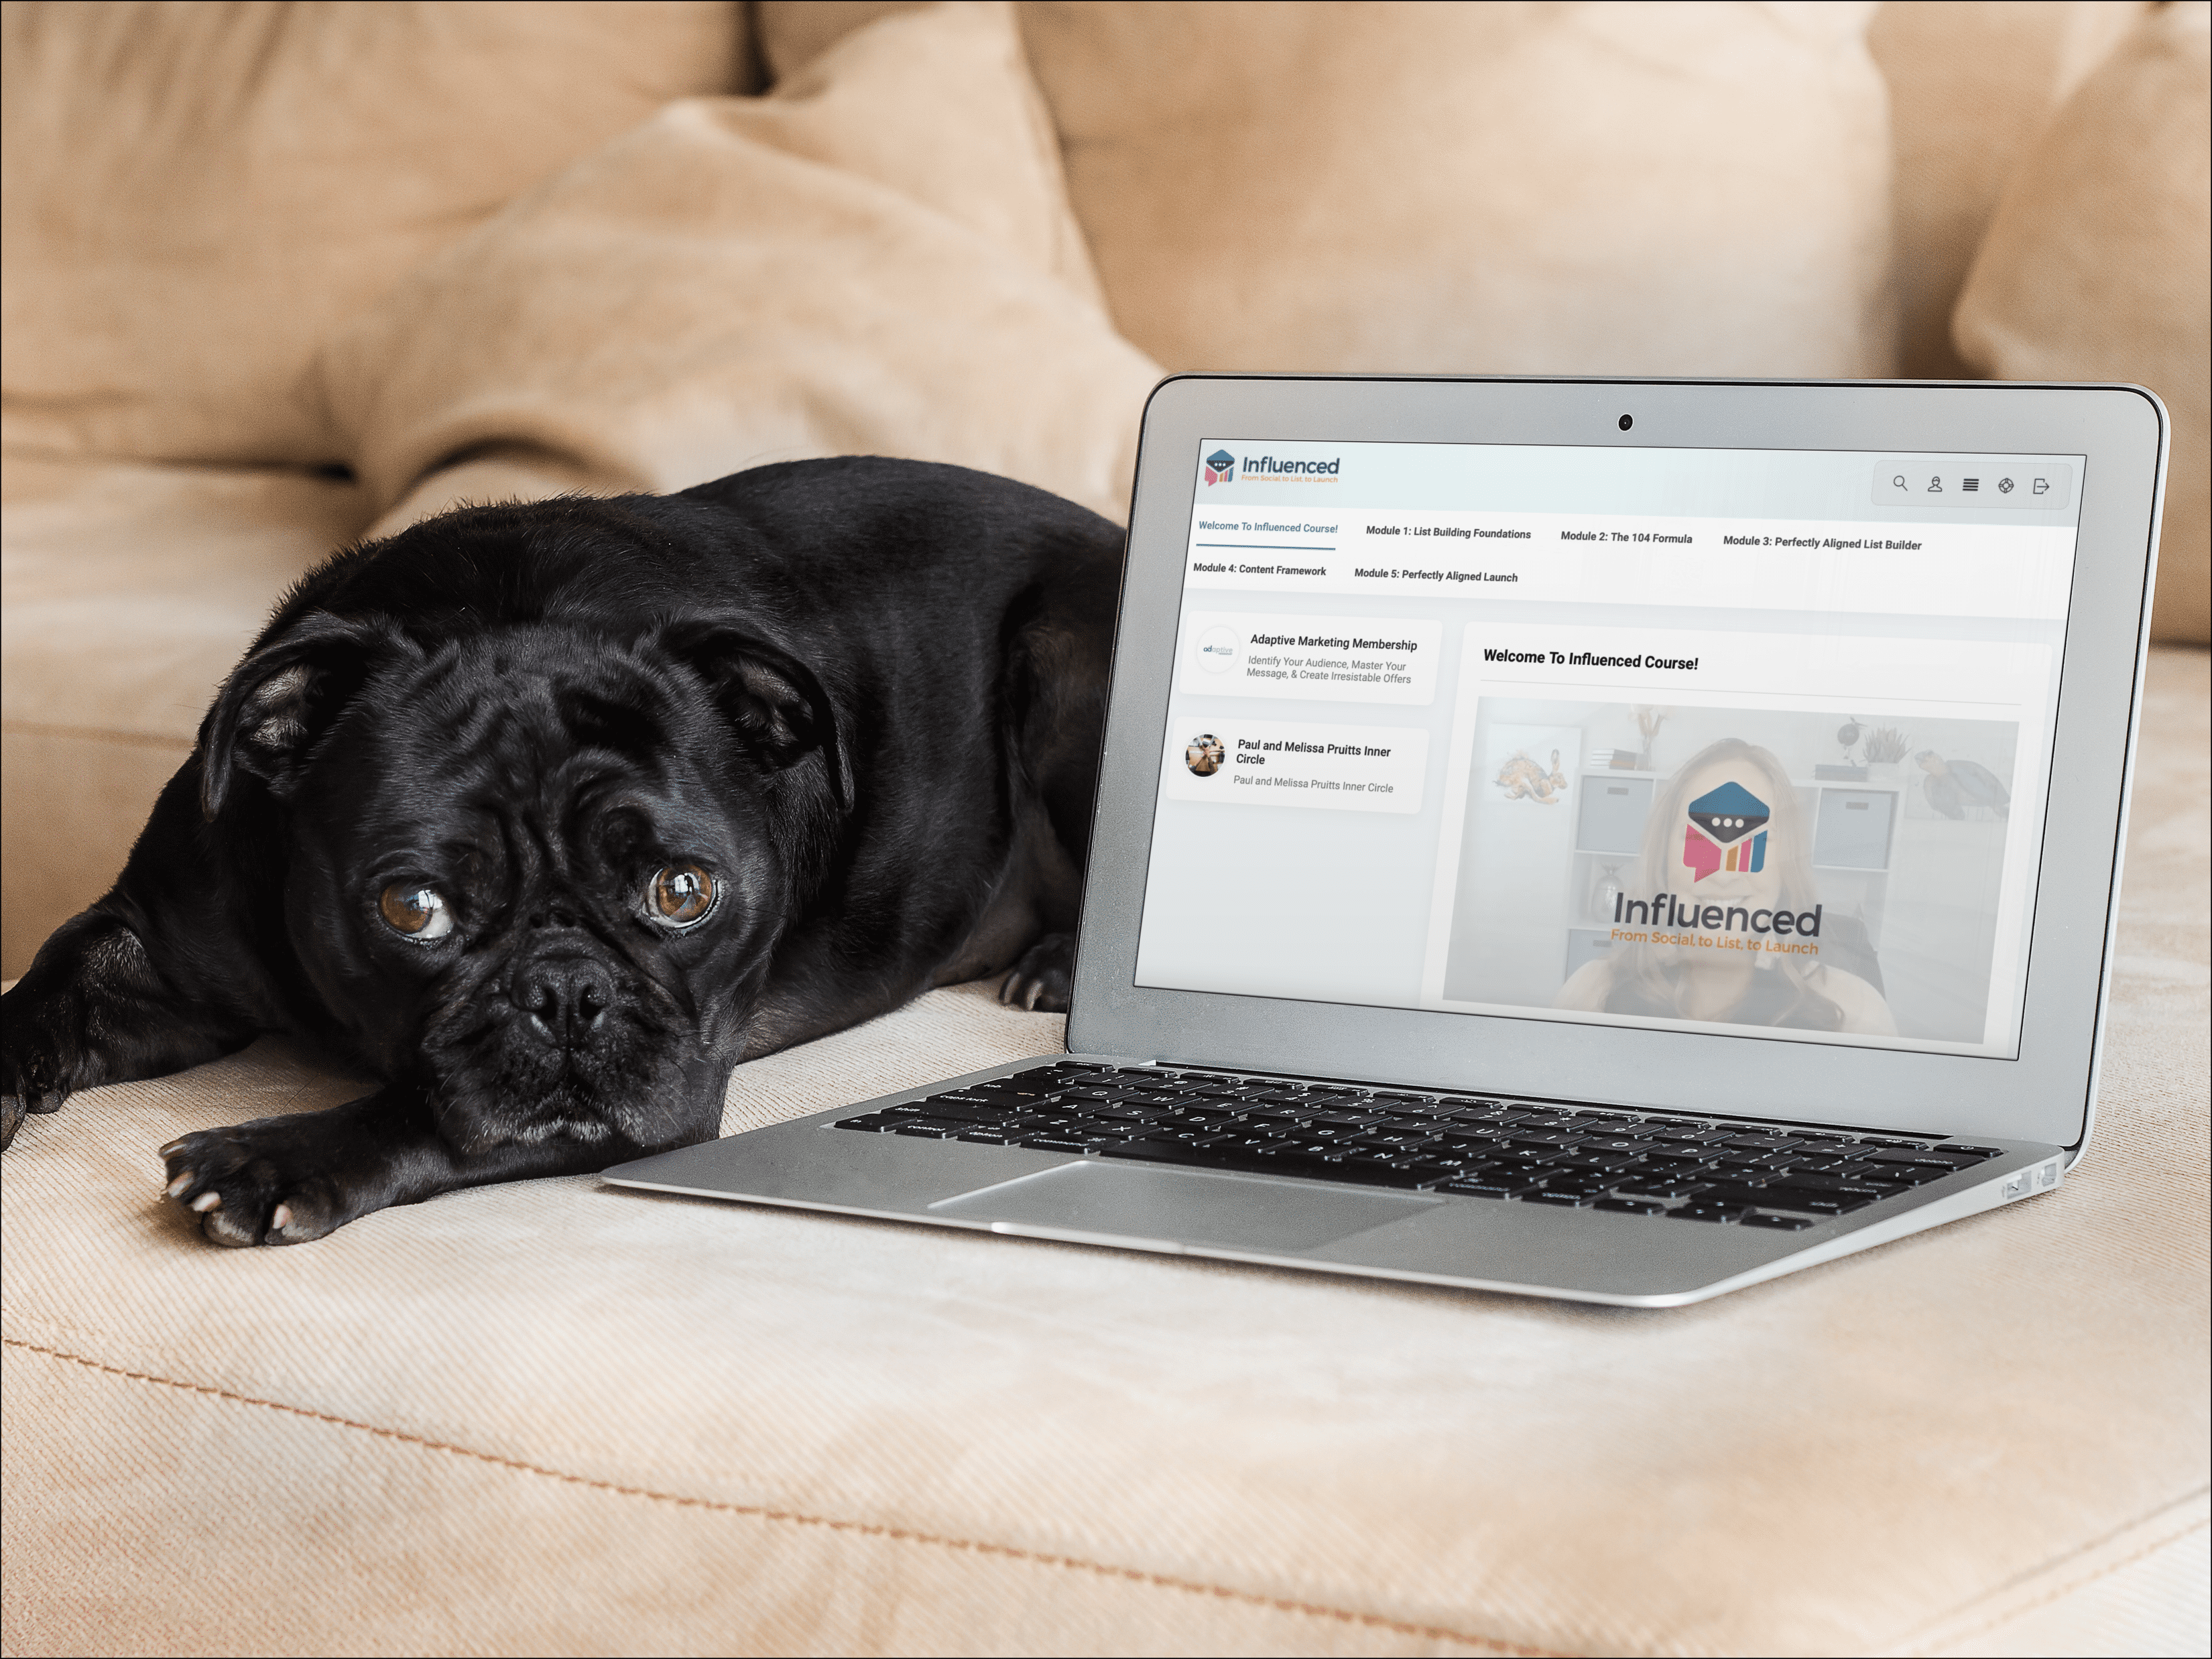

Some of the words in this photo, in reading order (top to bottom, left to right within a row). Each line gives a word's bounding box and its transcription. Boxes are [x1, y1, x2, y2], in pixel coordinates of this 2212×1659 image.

[1243, 456, 1340, 475] Influenced
[1199, 521, 1239, 530] Welcome
[1241, 522, 1251, 530] To
[1255, 522, 1301, 532] Influenced
[1304, 524, 1338, 533] Course!
[1366, 526, 1400, 535] Module
[1404, 527, 1411, 535] 1:
[1414, 527, 1431, 536] List
[1433, 528, 1471, 539] Building
[1473, 529, 1531, 539] Foundations
[1561, 531, 1597, 540] Module
[1599, 532, 1608, 541] 2:
[1611, 532, 1629, 542] The
[1632, 534, 1650, 542] 104
[1653, 534, 1693, 544] Formula
[1723, 536, 1760, 546] Module
[1763, 537, 1772, 546] 3:
[1775, 537, 1821, 549] Perfectly
[1823, 538, 1861, 550] Aligned
[1864, 540, 1883, 549] List
[1886, 540, 1922, 550] Builder
[1194, 563, 1226, 572] Module
[1228, 564, 1237, 572] 4:
[1239, 564, 1274, 574] Content
[1276, 566, 1327, 576] Framework
[1355, 568, 1388, 578] Module
[1391, 570, 1400, 578] 5:
[1402, 570, 1444, 582] Perfectly
[1446, 571, 1481, 582] Aligned
[1484, 572, 1518, 582] Launch
[1250, 634, 1295, 647] Adaptive
[1298, 636, 1349, 650] Marketing
[1353, 638, 1417, 653] Membership
[1249, 656, 1281, 667] Identify
[1284, 658, 1304, 666] Your
[1306, 658, 1349, 670] Audience,
[1352, 660, 1383, 670] Master
[1386, 662, 1406, 670] Your
[1484, 649, 1545, 664] Welcome
[1550, 652, 1564, 664] To
[1569, 652, 1642, 668] Influenced
[1645, 656, 1699, 670] Course!
[1247, 668, 1288, 680] Message,
[1291, 670, 1297, 678] &
[1300, 670, 1329, 680] Create
[1331, 672, 1381, 682] Irresistable
[1384, 674, 1411, 683] Offers
[1238, 739, 1260, 749] Paul
[1263, 741, 1282, 751] and
[1285, 741, 1324, 753] Melissa
[1327, 744, 1361, 755] Pruitts
[1364, 746, 1391, 757] Inner
[1237, 753, 1265, 764] Circle
[1234, 776, 1253, 784] Paul
[1255, 777, 1272, 786] and
[1274, 778, 1308, 788] Melissa
[1311, 780, 1340, 790] Pruitts
[1343, 782, 1365, 791] Inner
[1368, 783, 1394, 793] Circle
[1614, 892, 1823, 937] Influenced
[1611, 929, 1648, 942] From
[1651, 930, 1696, 946] Social,
[1698, 935, 1713, 948] to
[1717, 936, 1743, 951] List,
[1747, 938, 1762, 952] to
[1766, 940, 1819, 955] Launch
